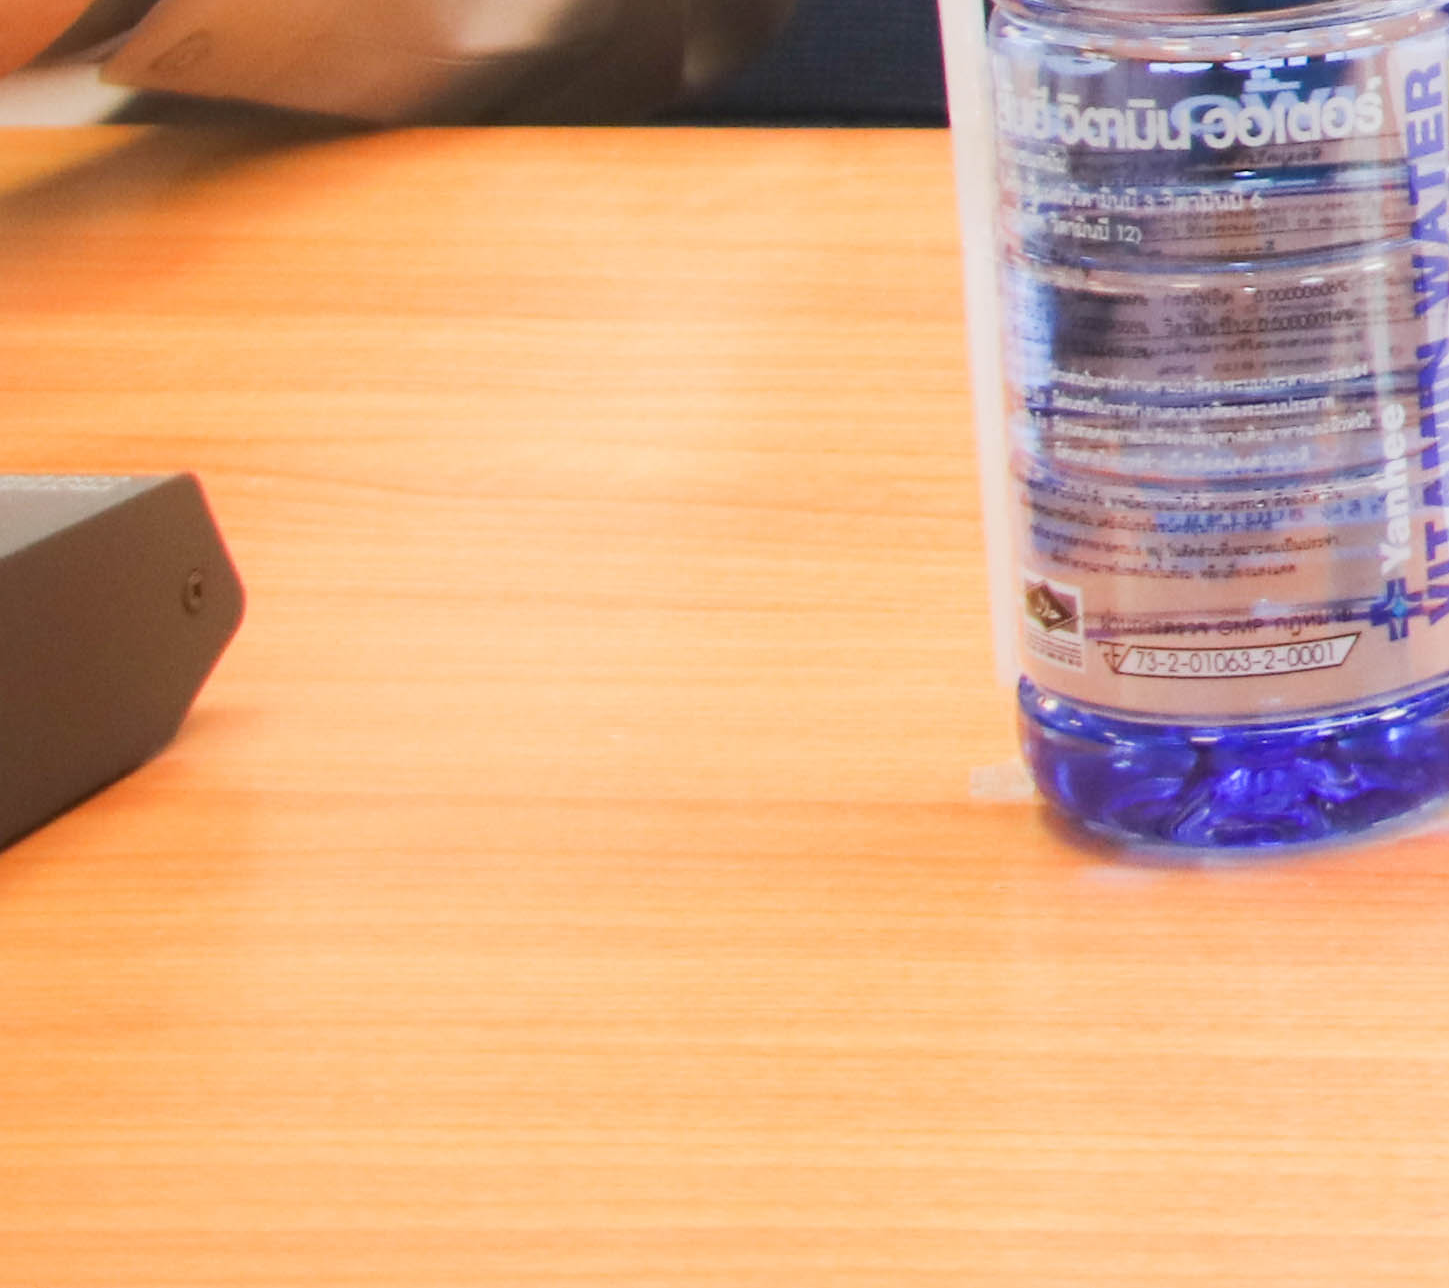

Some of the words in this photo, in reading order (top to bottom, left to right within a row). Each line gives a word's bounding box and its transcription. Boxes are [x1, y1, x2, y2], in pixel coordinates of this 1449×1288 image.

[1058, 92, 1192, 150] วิตามิน
[1201, 76, 1384, 150] วอเตอร์
[1380, 402, 1412, 576] Yanhee
[1135, 643, 1335, 673] 73-2-01063-2-0001
